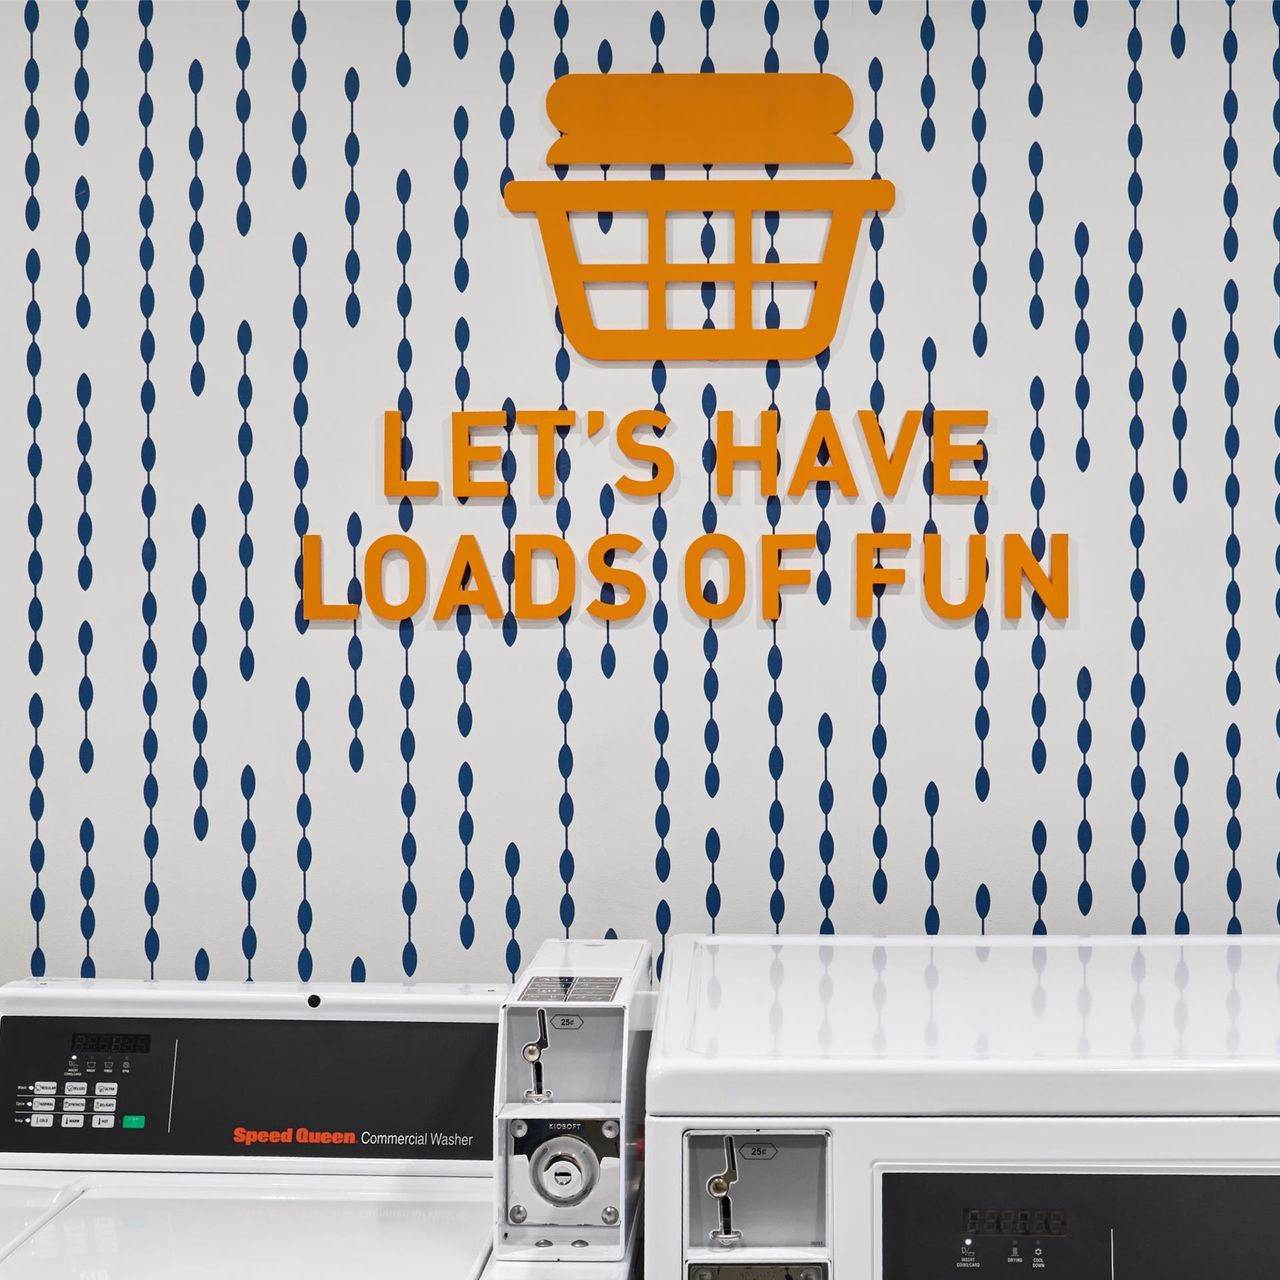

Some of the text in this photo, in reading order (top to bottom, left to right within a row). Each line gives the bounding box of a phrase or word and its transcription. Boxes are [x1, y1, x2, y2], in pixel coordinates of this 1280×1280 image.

[384, 410, 989, 497] LET'S HAVE
[303, 533, 1069, 621] LOADS OF FUN
[233, 1128, 474, 1146] Speed Queen Commercial Washer
